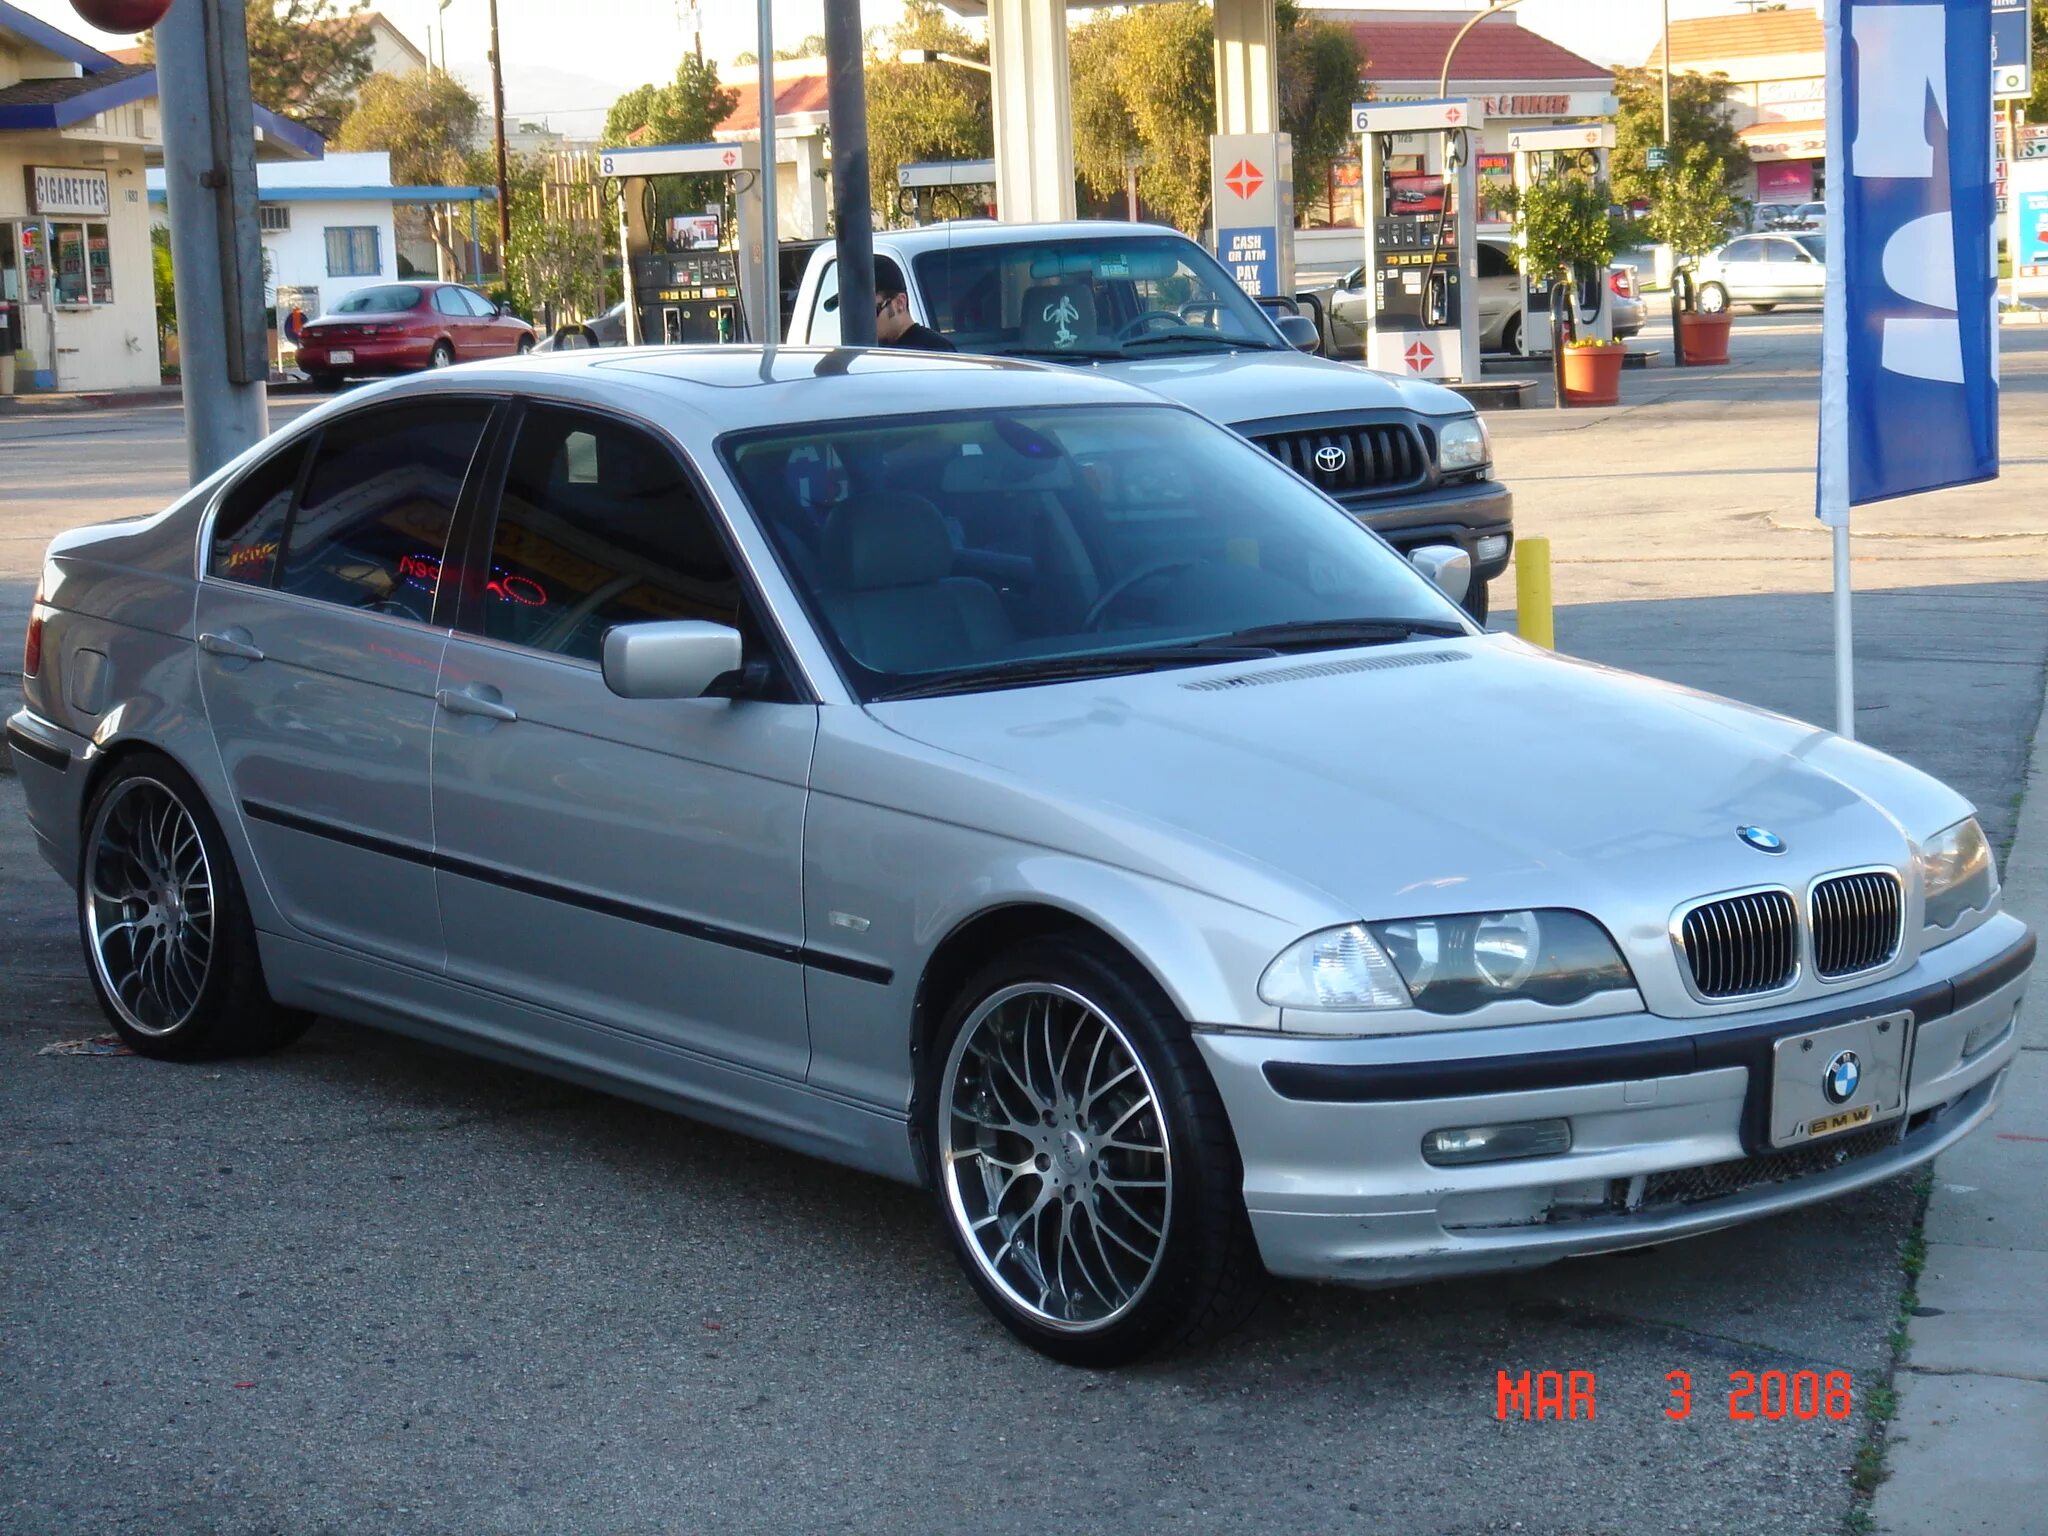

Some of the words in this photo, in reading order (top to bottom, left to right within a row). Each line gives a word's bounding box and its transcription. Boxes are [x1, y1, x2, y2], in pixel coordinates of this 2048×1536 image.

[1356, 111, 1369, 130] 6
[1511, 135, 1521, 149] 4
[603, 157, 614, 174] 8
[901, 170, 911, 184] 2
[37, 175, 106, 207] CIGARETTES
[1233, 235, 1261, 250] CASH
[1228, 251, 1242, 262] OR
[1244, 250, 1266, 261] ATM
[1236, 265, 1259, 280] PAY
[1377, 270, 1385, 281] 6
[1812, 1108, 1869, 1133] BMW
